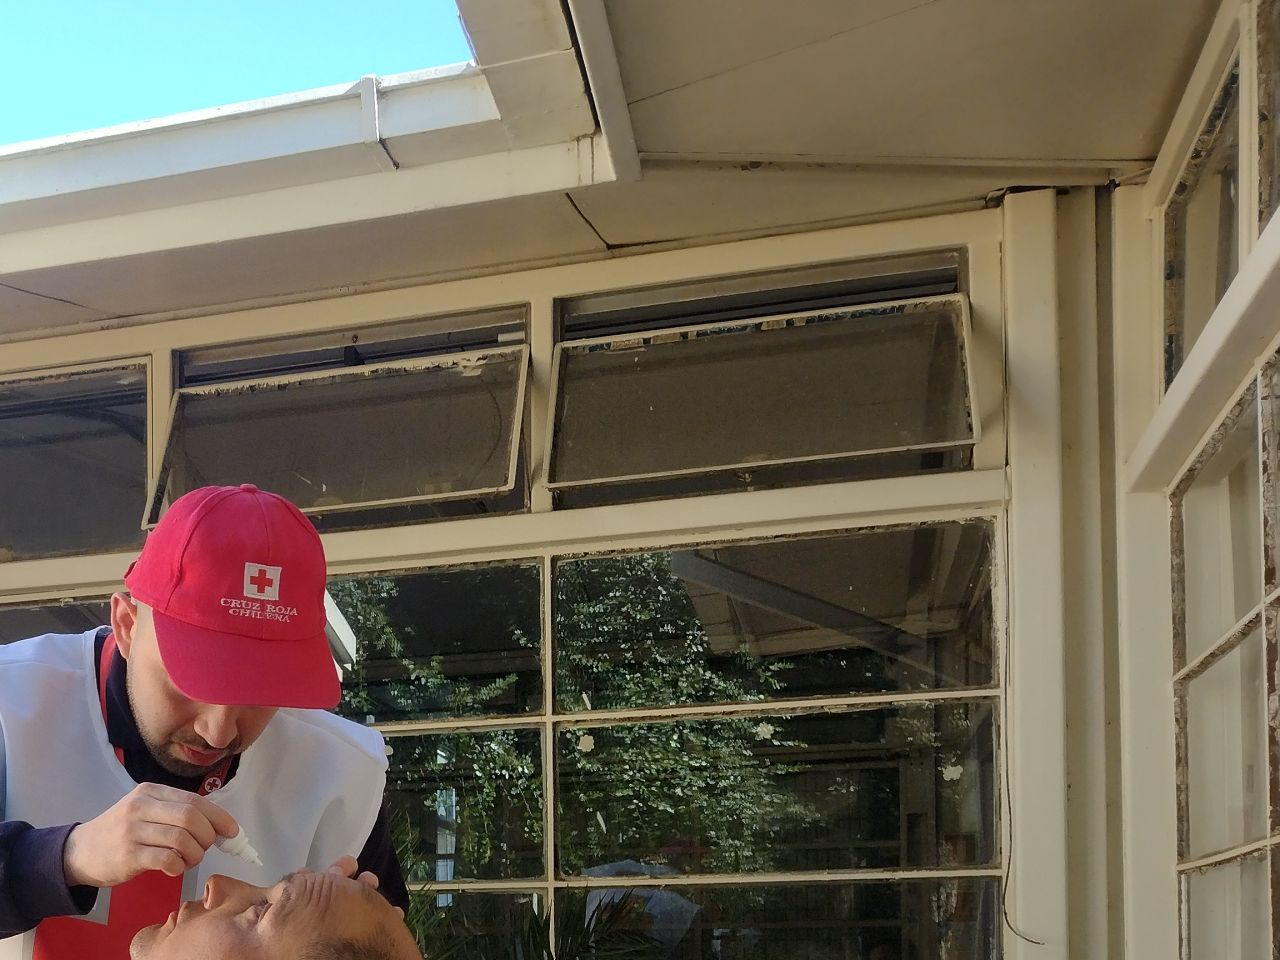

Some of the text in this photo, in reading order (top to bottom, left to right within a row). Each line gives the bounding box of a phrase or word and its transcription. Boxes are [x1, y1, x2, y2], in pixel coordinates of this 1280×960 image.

[220, 597, 298, 616] CRUZ ROJA
[228, 608, 291, 623] CHILENA
